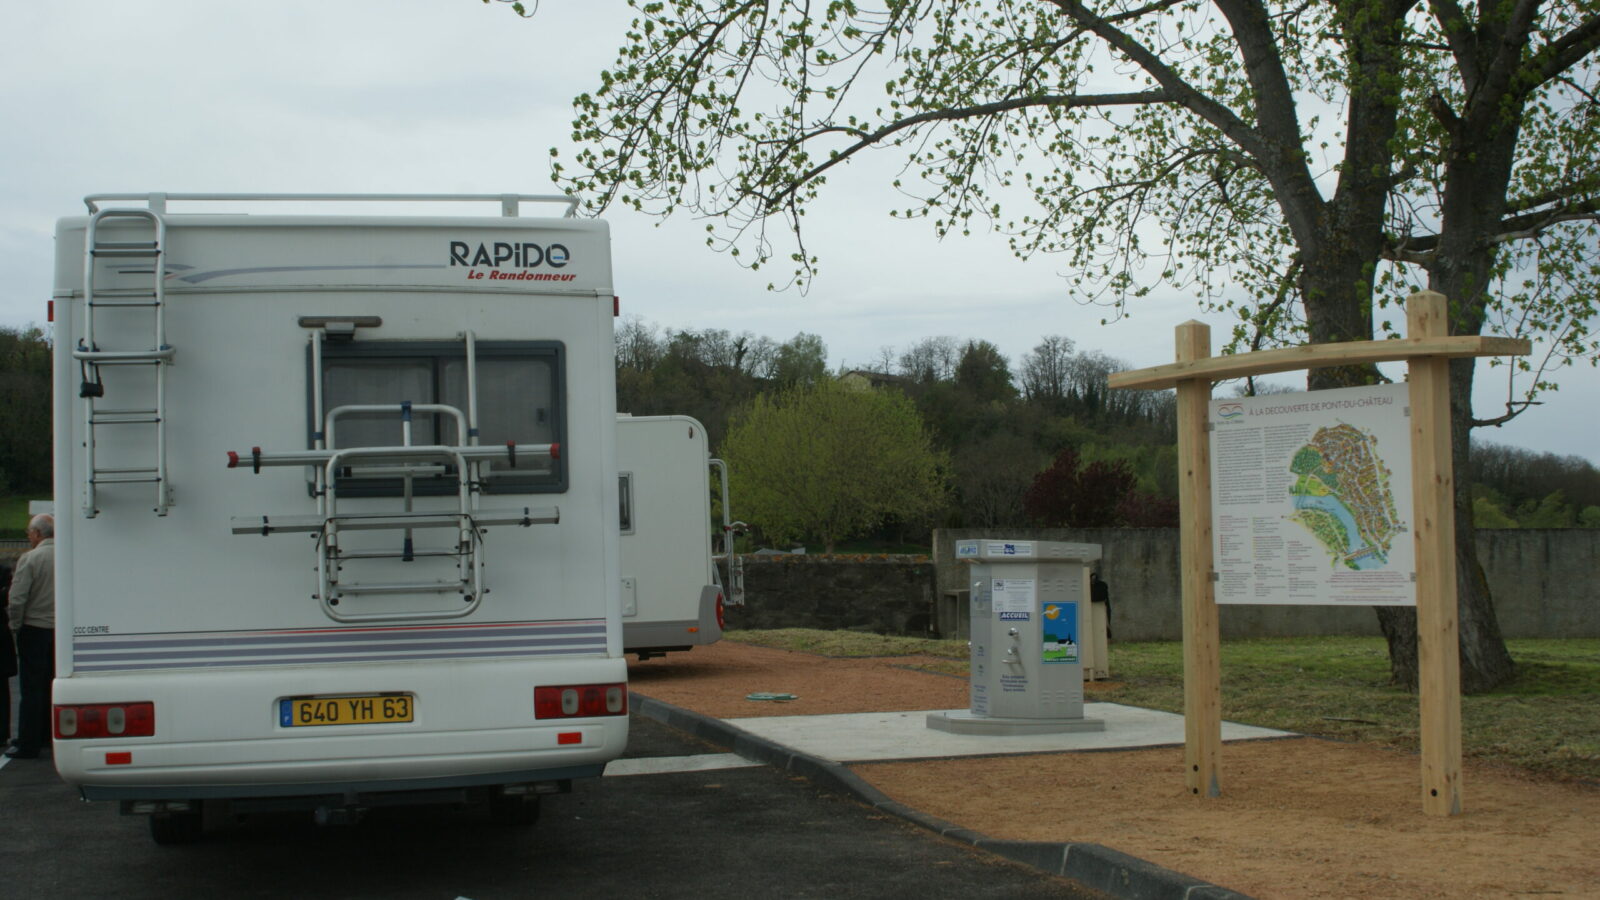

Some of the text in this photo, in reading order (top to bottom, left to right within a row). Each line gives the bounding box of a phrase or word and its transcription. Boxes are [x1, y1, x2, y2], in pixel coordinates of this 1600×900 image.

[450, 241, 570, 268] RAPIDO
[467, 269, 577, 282] Le Randonneur
[300, 698, 408, 723] 640 YH 63
